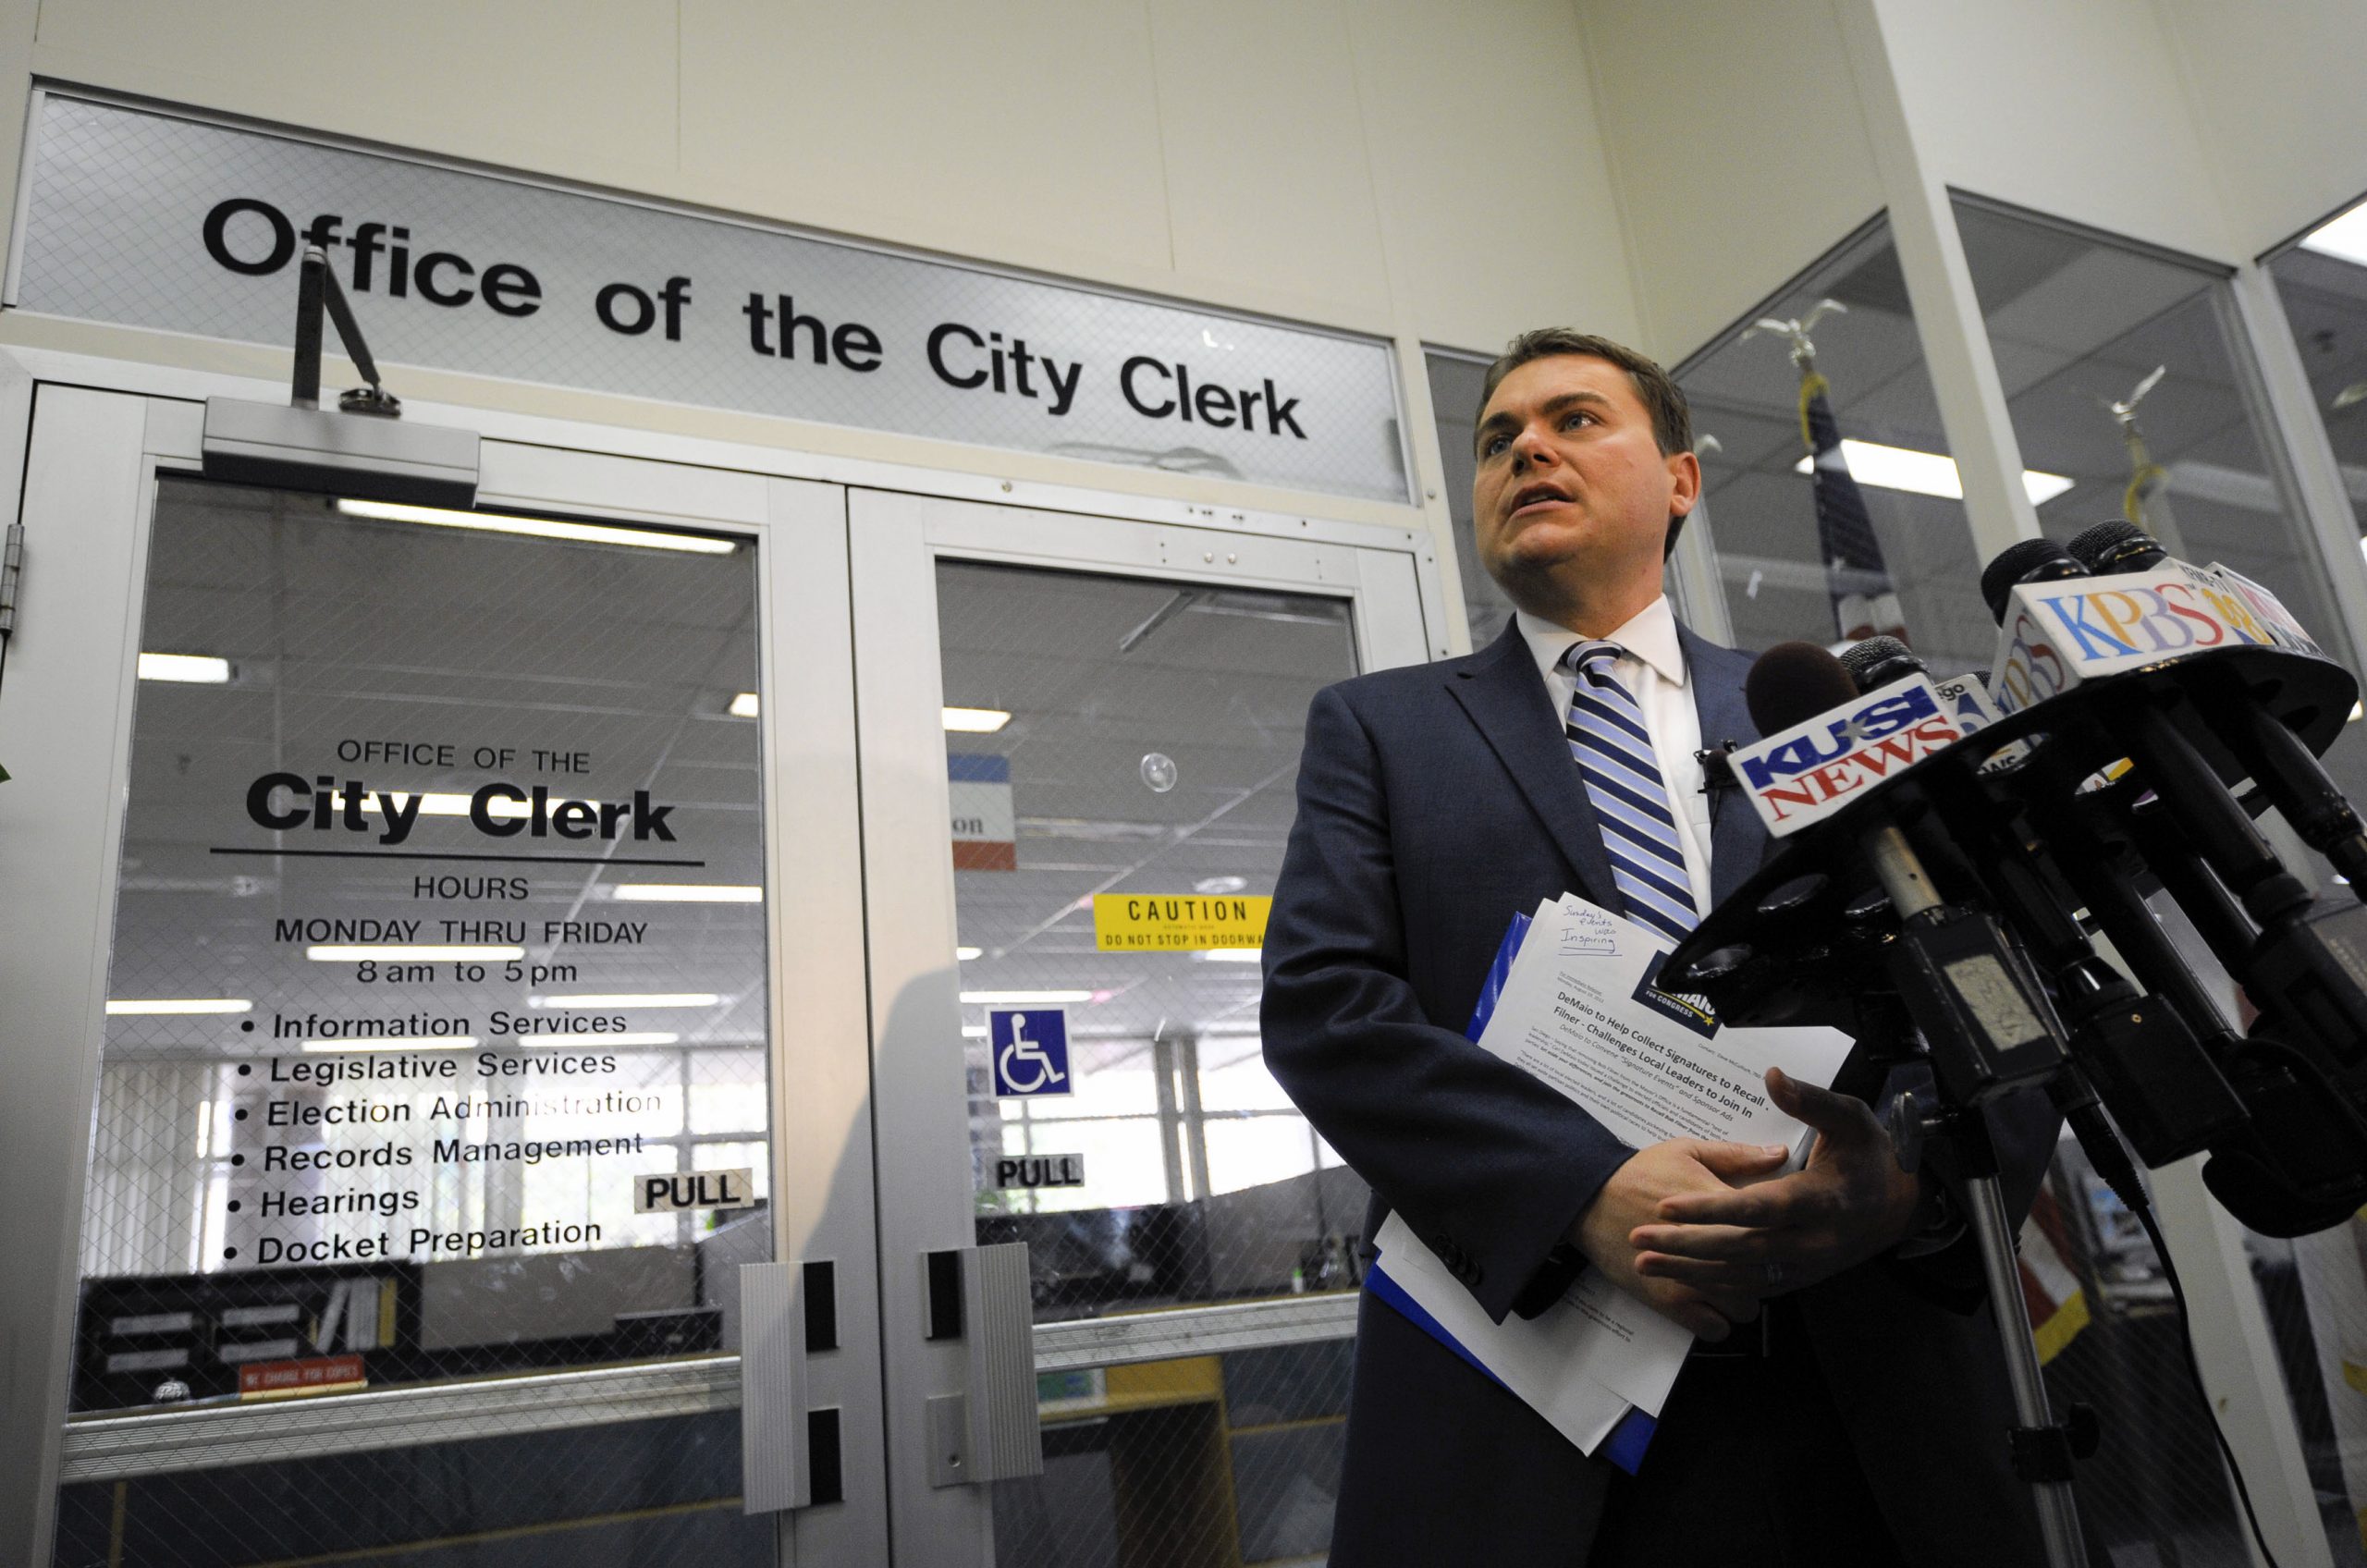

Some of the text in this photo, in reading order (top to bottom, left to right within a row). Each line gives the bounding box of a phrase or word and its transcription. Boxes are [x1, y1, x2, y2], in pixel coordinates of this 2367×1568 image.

[202, 198, 1307, 440] Office of the City Clerk
[2036, 583, 2224, 661] KPBS
[1741, 685, 1939, 790] KUSI
[337, 741, 590, 773] OFFICE OF THE
[1760, 715, 1959, 823] NEWS
[246, 772, 677, 845] City Clerk
[413, 876, 529, 900] HOURS
[1128, 900, 1246, 921] CAUTION
[275, 919, 648, 944] MONDAY THRU FRIDAY
[1106, 935, 1263, 946] DO NOT STOP IN DOORWA
[1560, 927, 1615, 952] Inspiring
[456, 961, 485, 983] to
[1657, 995, 1693, 1017] CONGRESS
[274, 1011, 627, 1039] Information Services
[1553, 1006, 1580, 1024] Filner
[1587, 1023, 1637, 1056] Challenges
[1638, 1051, 1666, 1071] Local
[1665, 1066, 1705, 1092] Leaders
[1706, 1088, 1718, 1099] to
[1718, 1095, 1740, 1112] Join
[1741, 1107, 1752, 1119] In
[1557, 991, 1765, 1107] DeMaio to Help Collect Signatures to Recall
[270, 1051, 616, 1086] Legislative Services
[1559, 1023, 1584, 1040] DeMaio
[1591, 1041, 1619, 1059] Convene
[1678, 1089, 1694, 1099] and
[1692, 1096, 1720, 1113] Sponsor
[1720, 1111, 1734, 1121] Ads
[267, 1091, 662, 1128] Election Administration
[264, 1133, 644, 1171] Records Management
[997, 1157, 1081, 1189] PULL
[261, 1188, 419, 1219] Hearings
[644, 1174, 741, 1210] PULL
[258, 1222, 602, 1265] Docket Preparation
